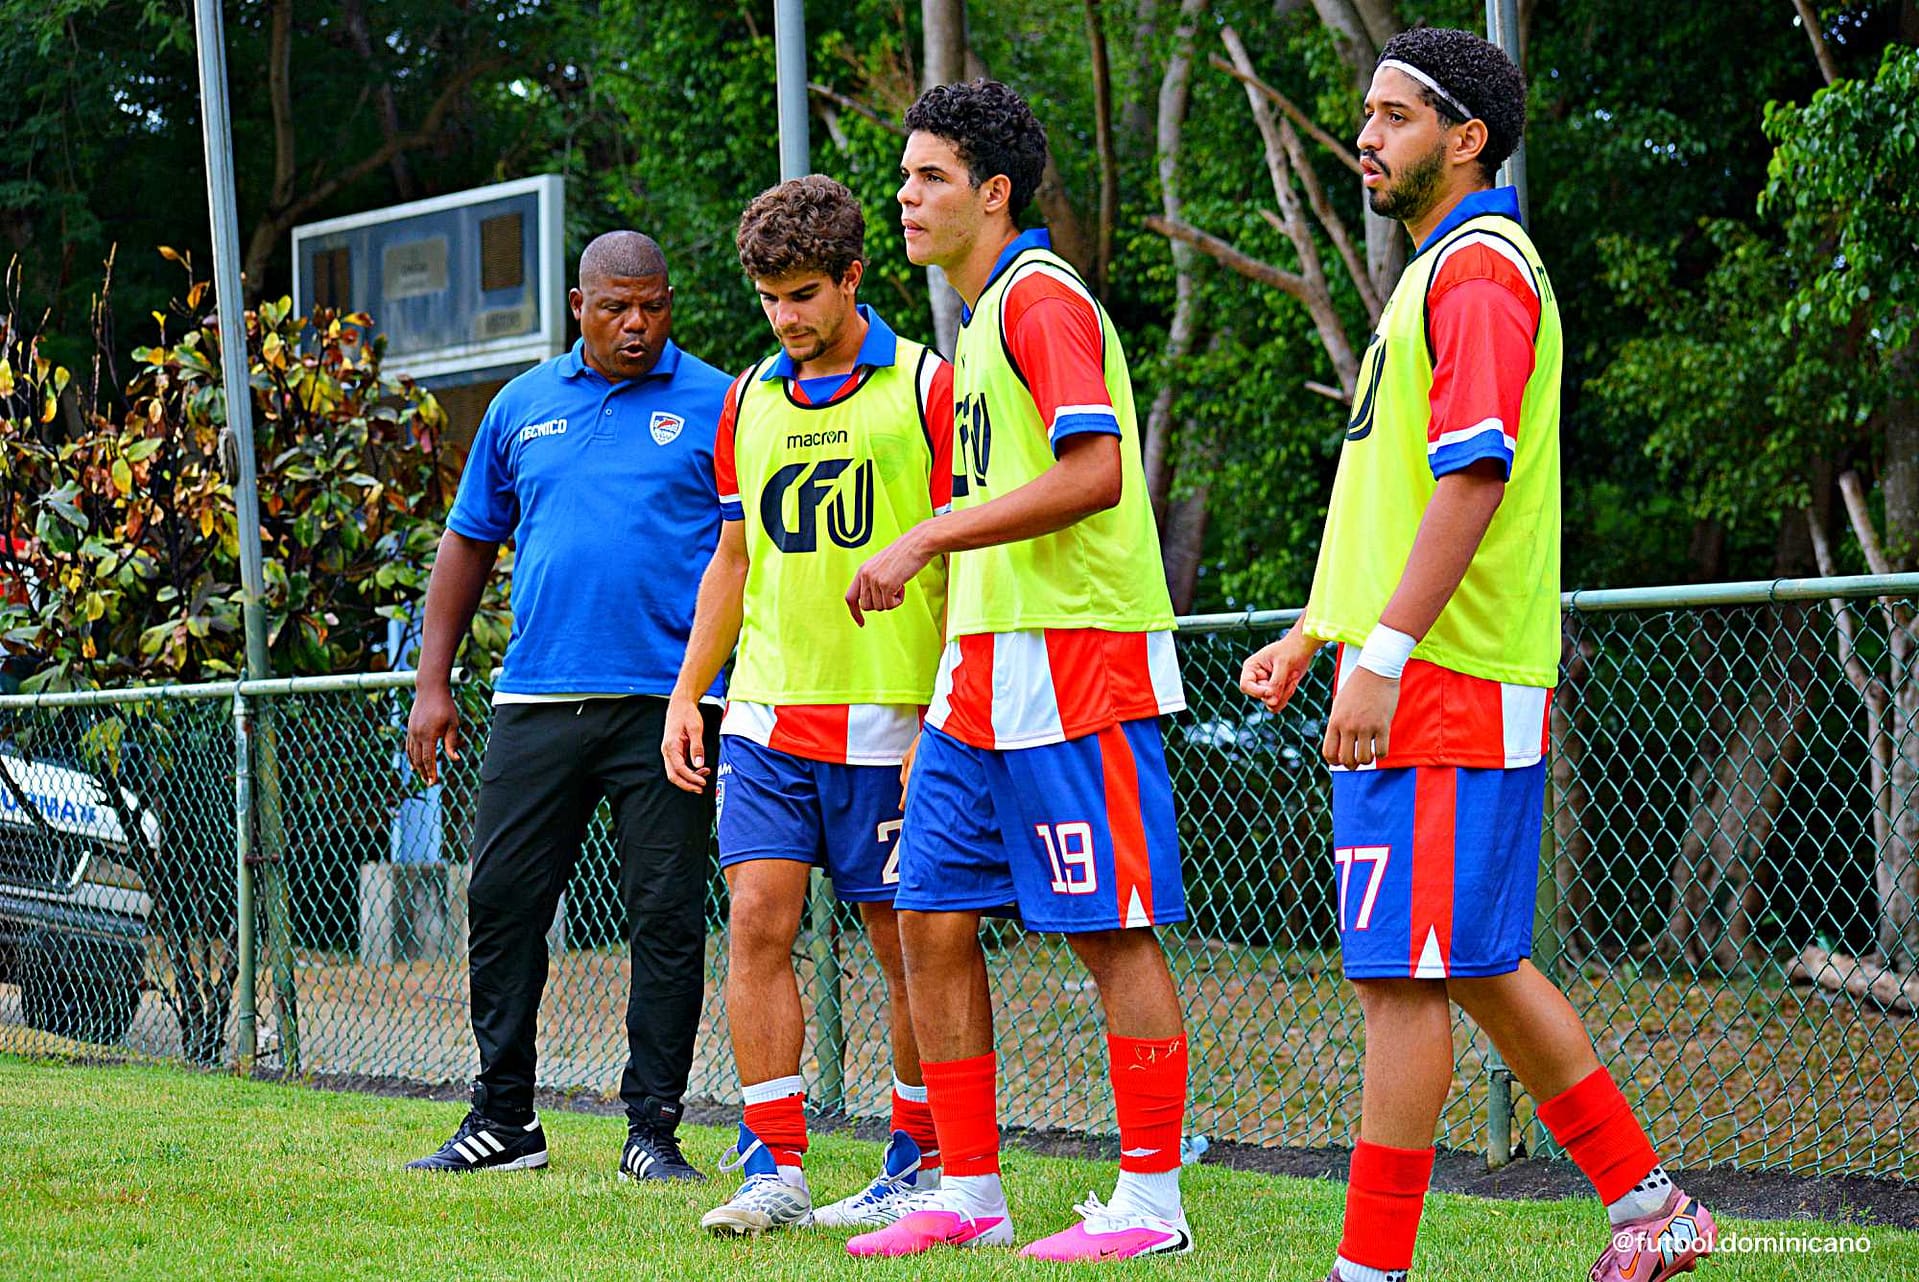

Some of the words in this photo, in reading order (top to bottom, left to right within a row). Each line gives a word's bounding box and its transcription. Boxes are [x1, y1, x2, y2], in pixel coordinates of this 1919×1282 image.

[519, 418, 568, 443] TECNICO
[787, 430, 848, 449] macron
[760, 458, 874, 553] CFU
[1035, 821, 1098, 895] 19
